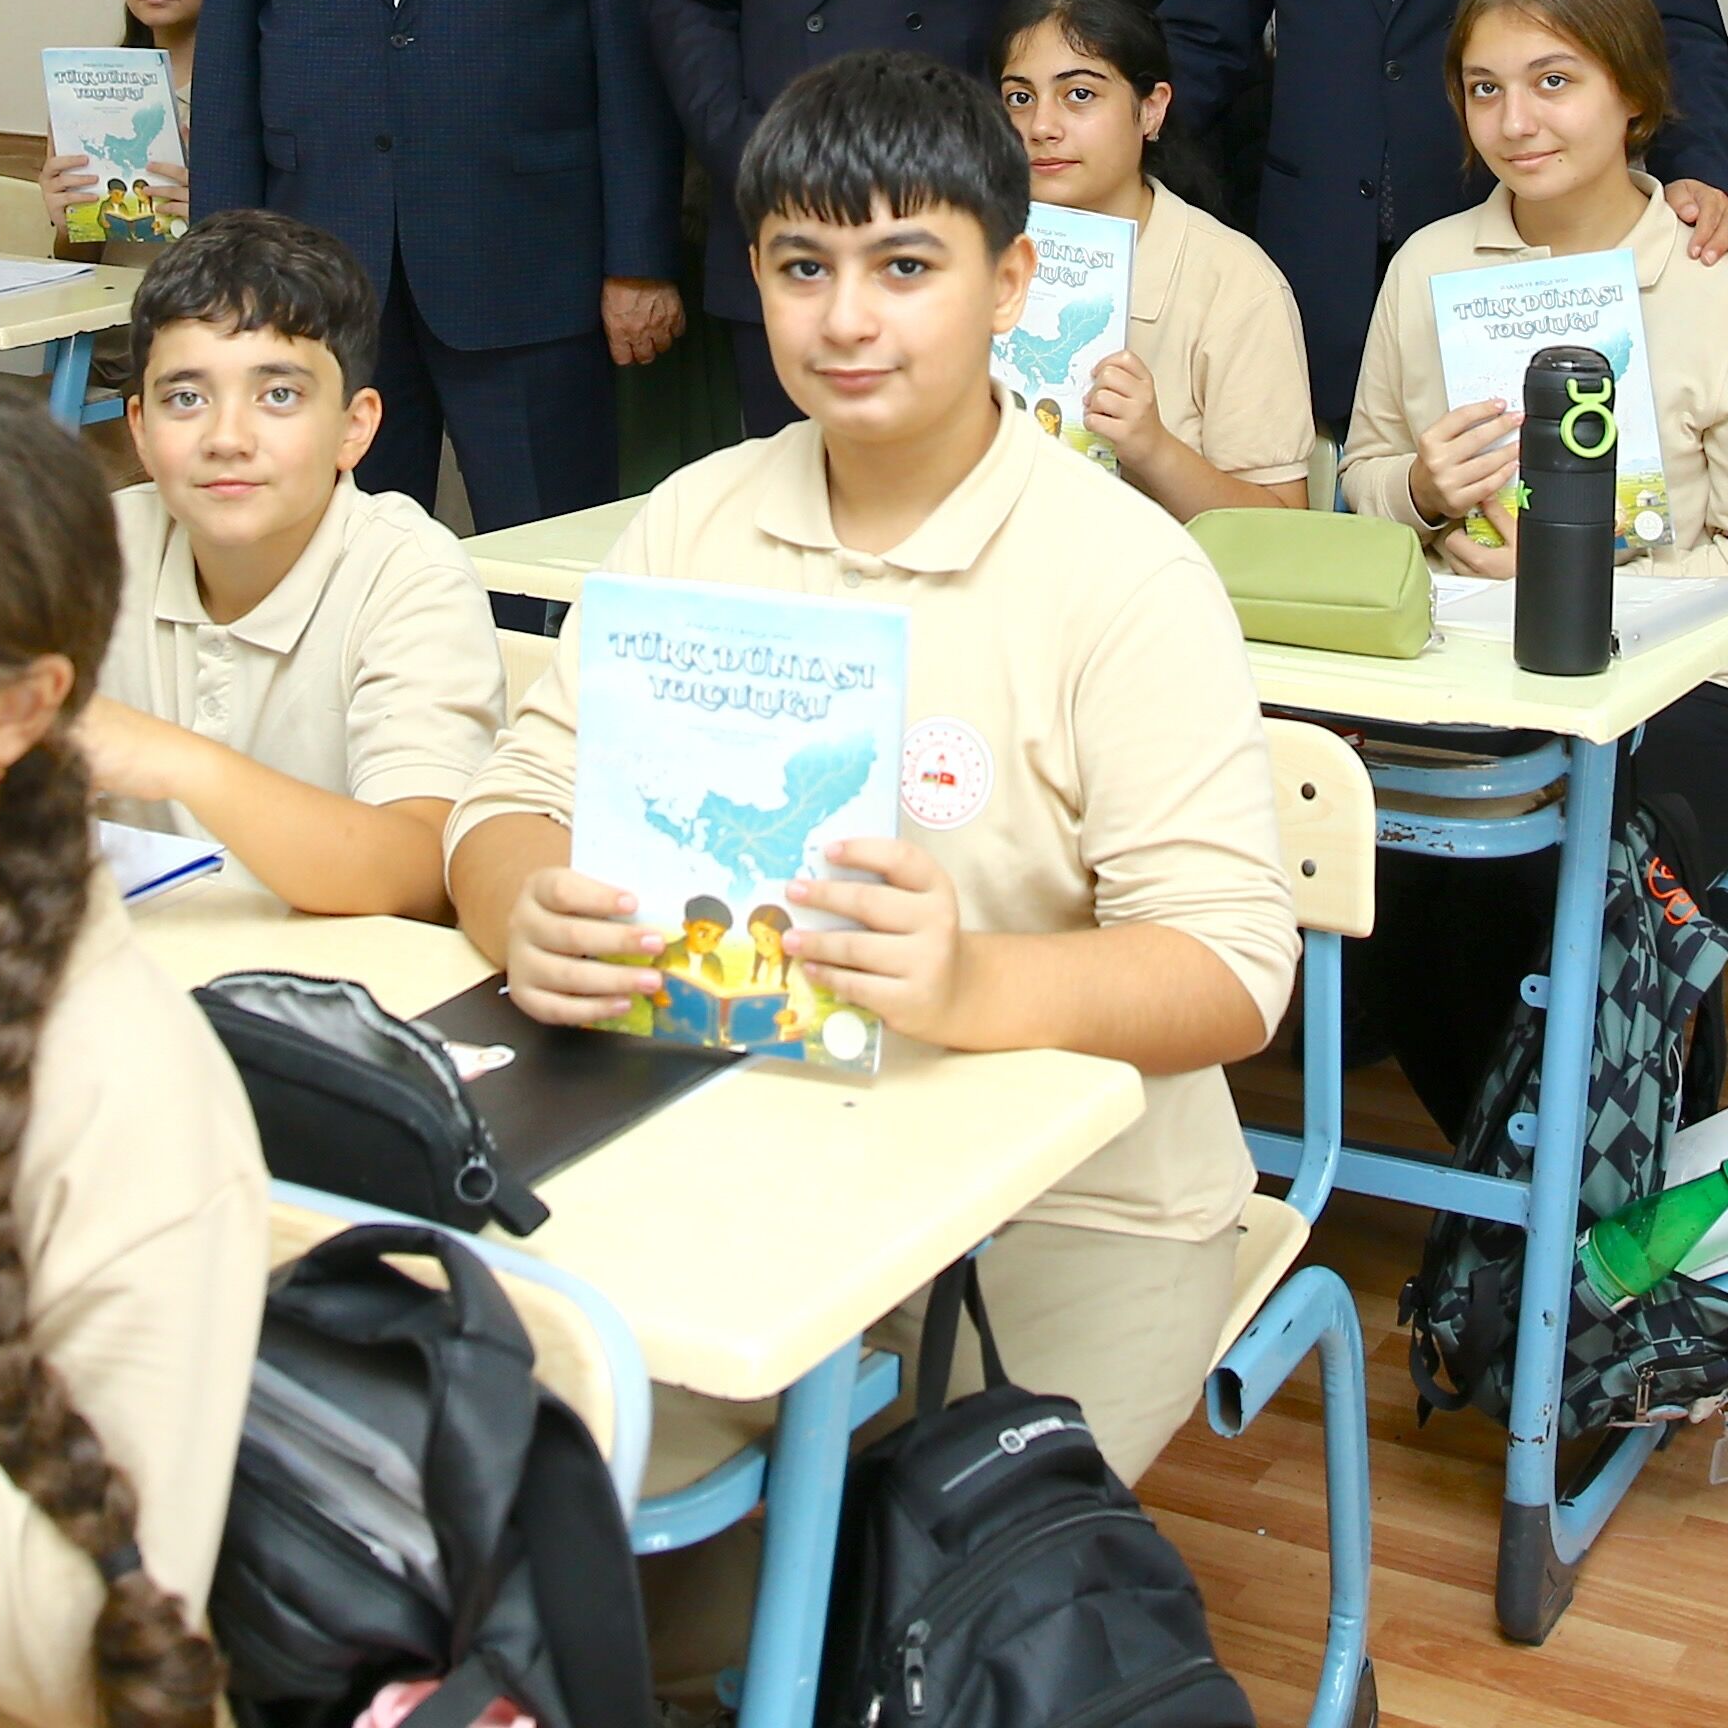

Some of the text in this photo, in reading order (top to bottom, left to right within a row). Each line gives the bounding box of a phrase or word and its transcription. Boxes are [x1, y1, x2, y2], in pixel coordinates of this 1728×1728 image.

[54, 69, 98, 85] TÜRK
[1032, 239, 1114, 269] ÜNYASI
[1453, 285, 1623, 320] TÜRK DÜNYASI
[1484, 310, 1599, 340] YOLCULUĞU
[608, 632, 875, 690] TÜRK DÜNYASI
[649, 675, 831, 722] YOLCULUĞU
